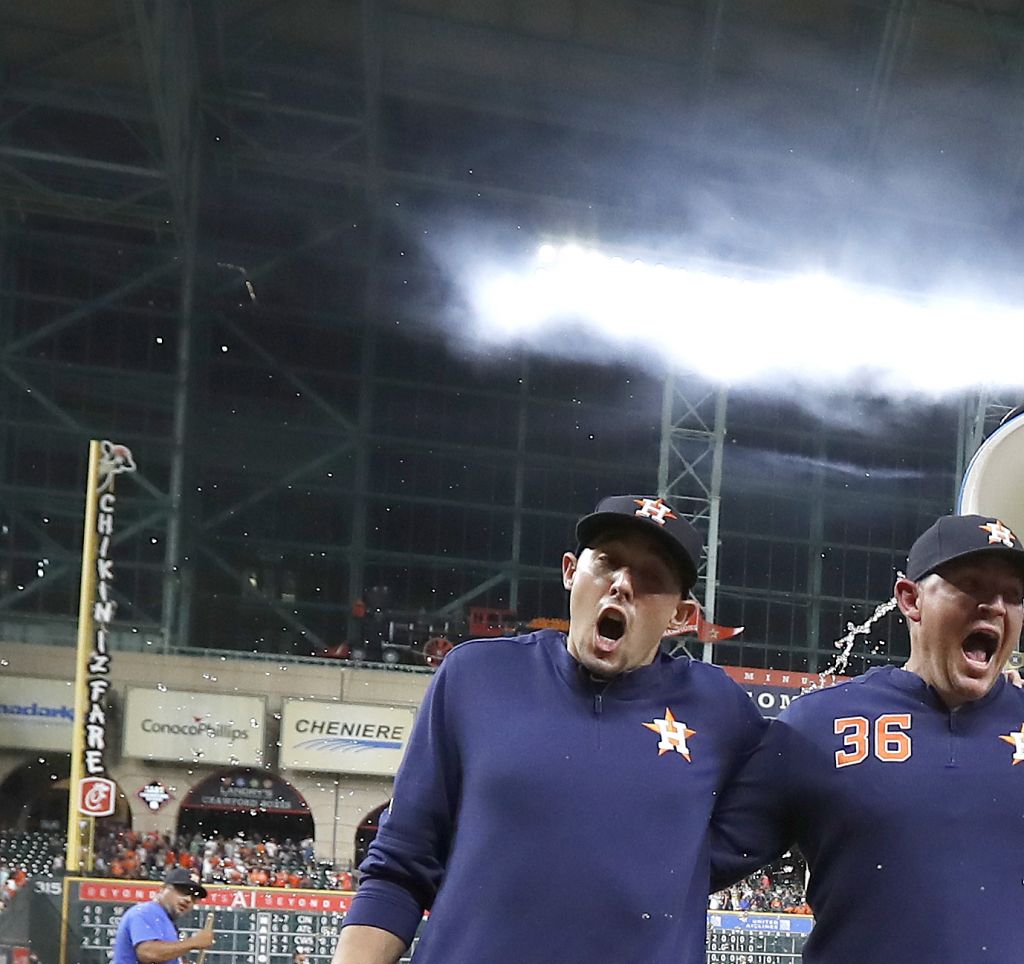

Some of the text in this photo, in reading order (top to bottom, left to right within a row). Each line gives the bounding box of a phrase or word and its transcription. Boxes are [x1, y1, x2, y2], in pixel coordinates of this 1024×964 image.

[85, 493, 116, 774] CHIKIN IZ FARE
[294, 718, 405, 740] CHENIERE
[833, 712, 913, 769] 36
[33, 881, 63, 896] 315
